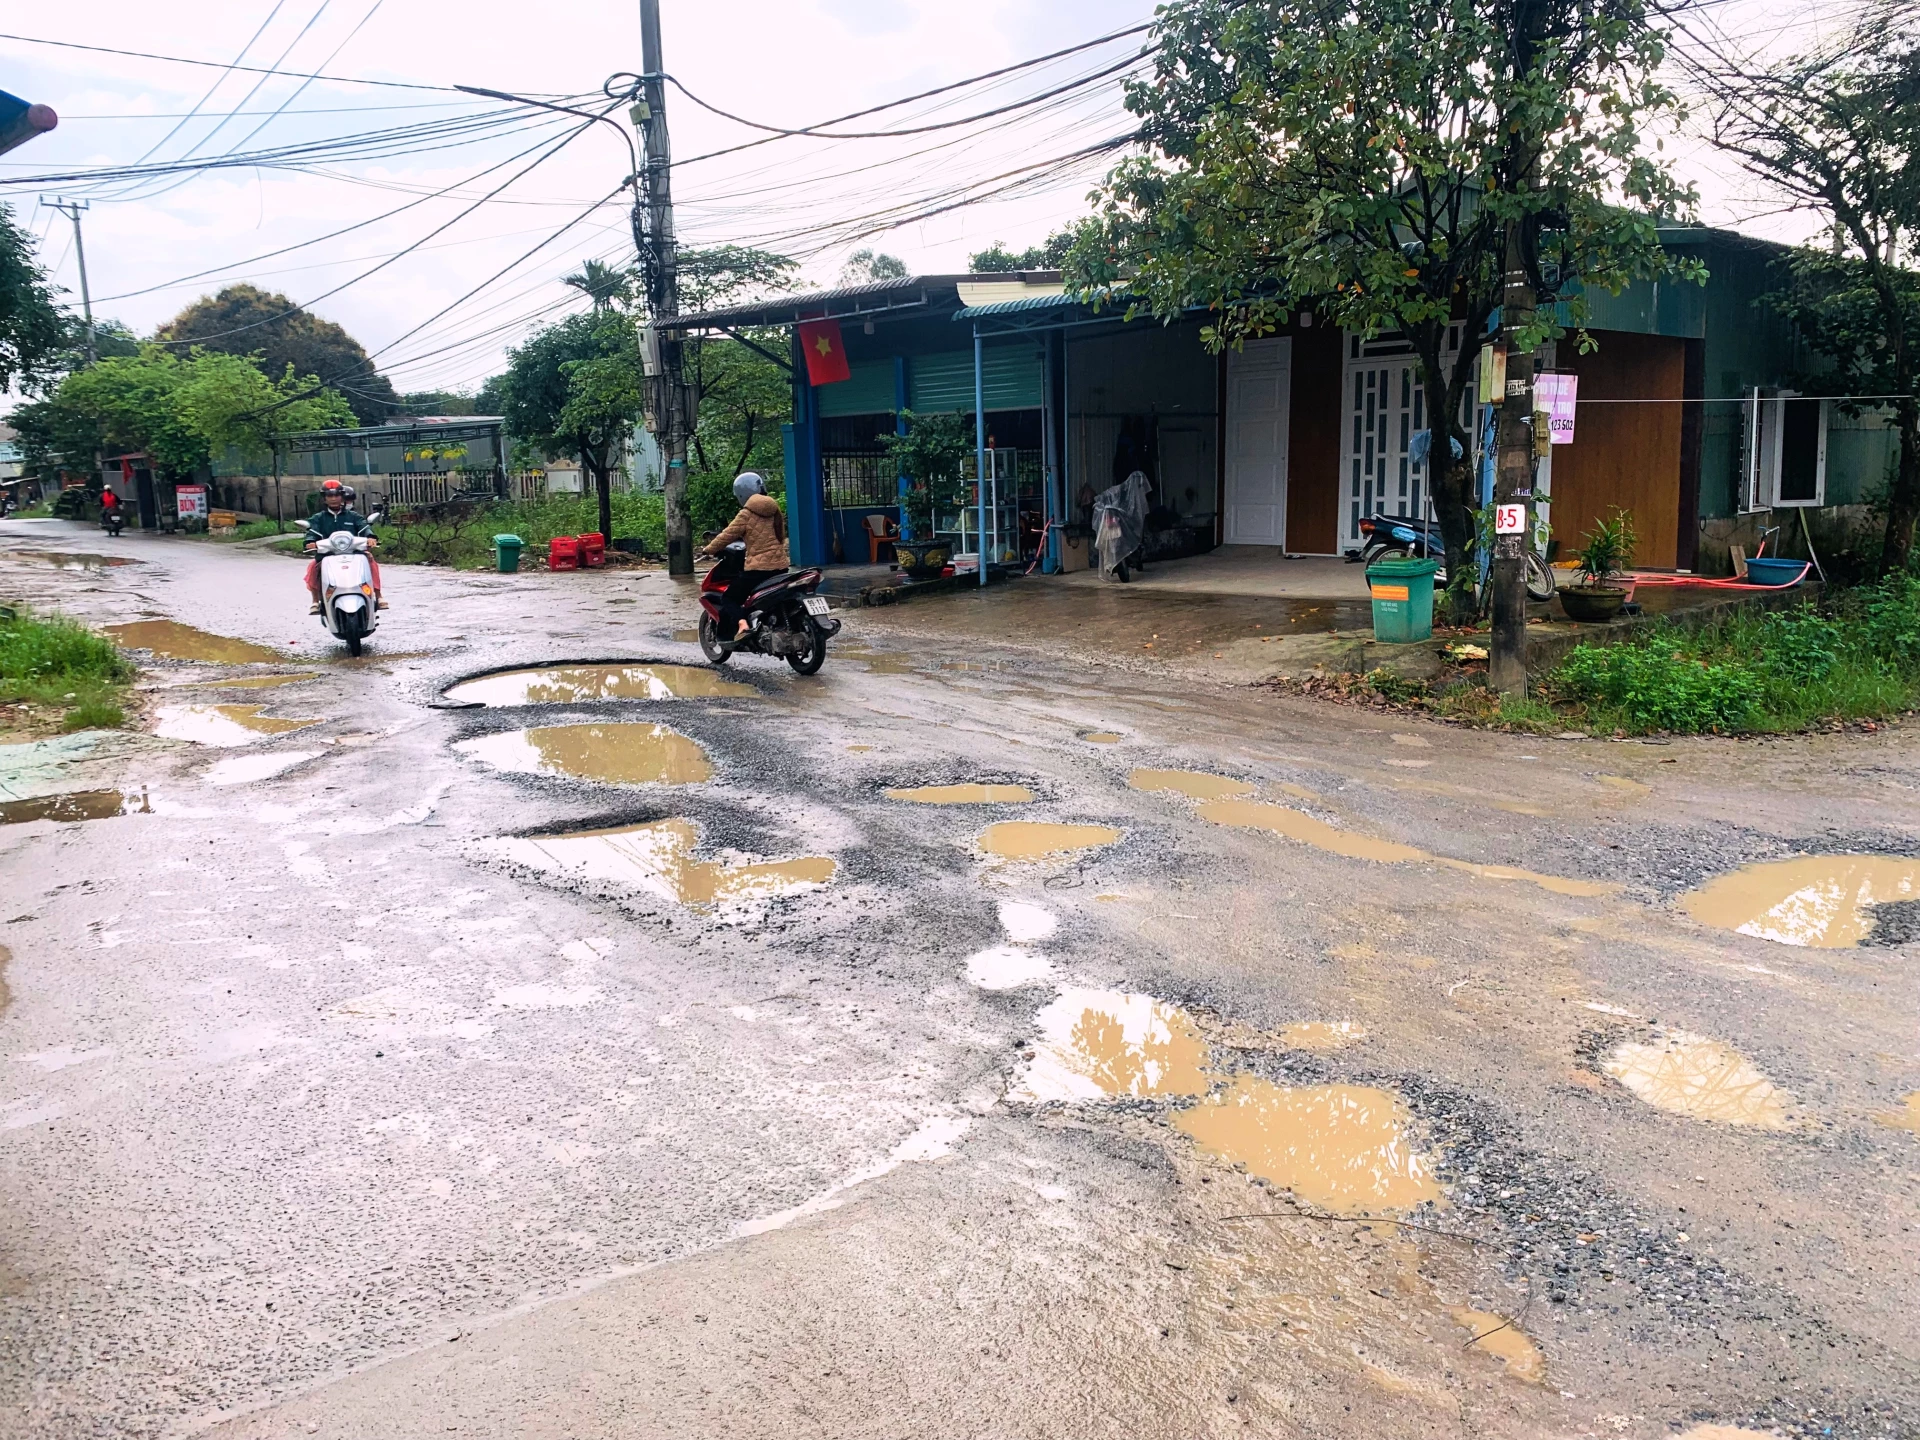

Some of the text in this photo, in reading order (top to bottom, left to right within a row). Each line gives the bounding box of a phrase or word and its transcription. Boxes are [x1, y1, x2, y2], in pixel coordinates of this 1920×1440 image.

[1533, 382, 1548, 395] CHO
[1557, 401, 1572, 417] TRỌ
[1551, 418, 1573, 431] 123 502
[1497, 508, 1517, 529] B-5
